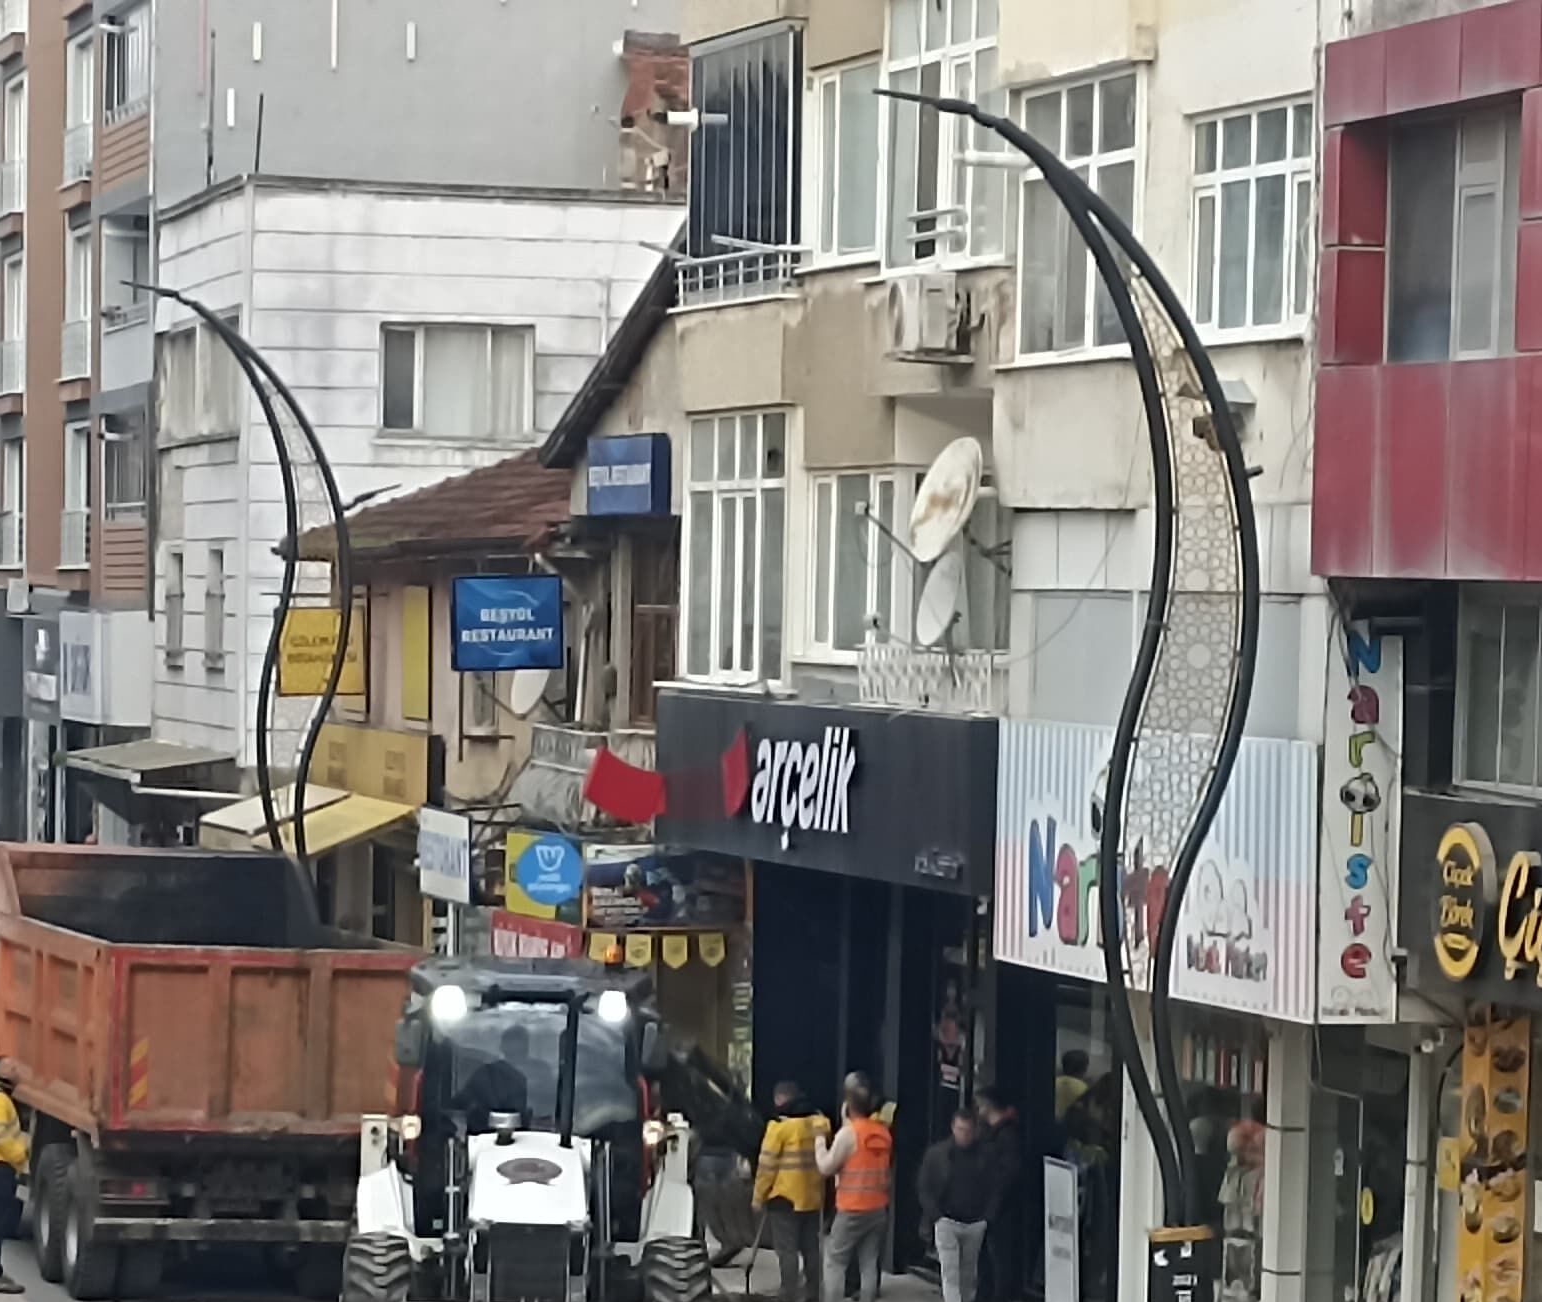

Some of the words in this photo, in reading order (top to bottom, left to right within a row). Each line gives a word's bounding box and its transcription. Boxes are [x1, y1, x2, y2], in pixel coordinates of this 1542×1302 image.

[480, 607, 535, 624] BEŞYOL
[461, 627, 554, 643] RESTAURANT
[751, 725, 856, 851] arçelik
